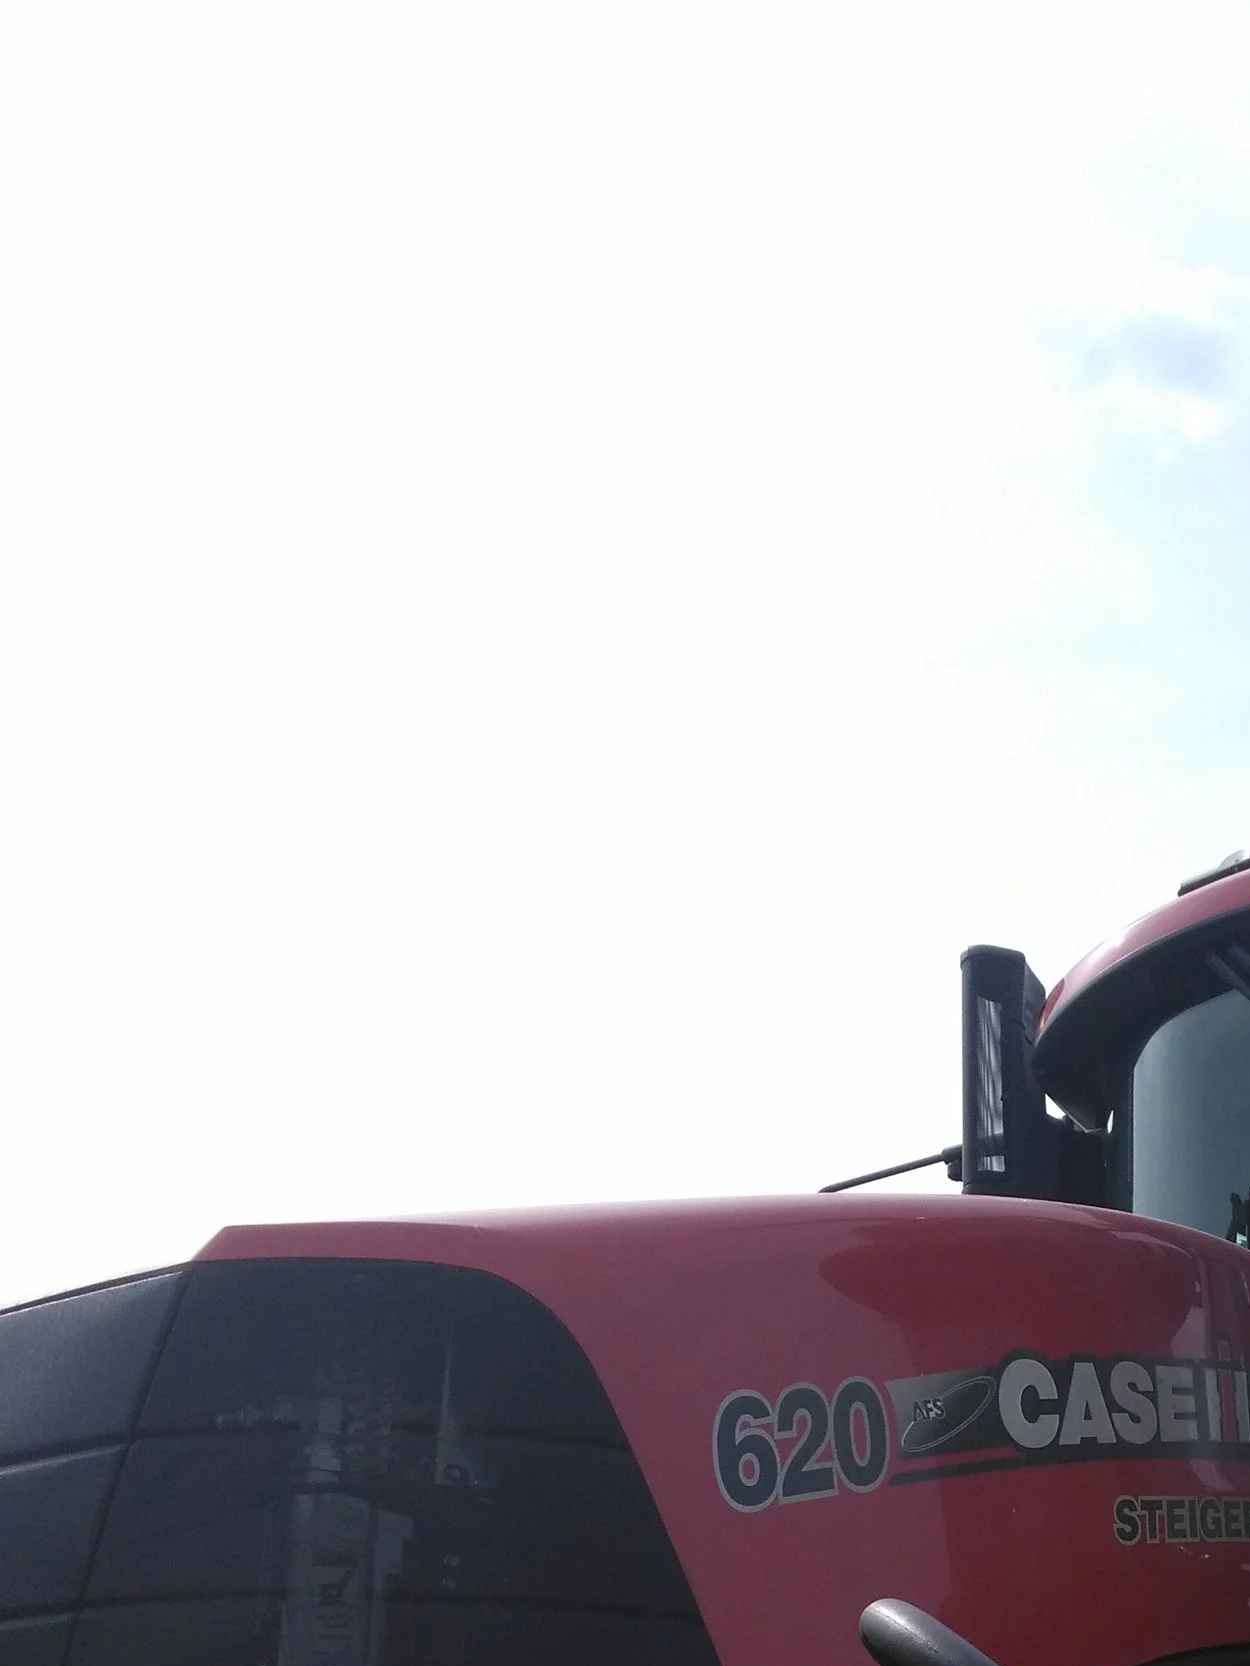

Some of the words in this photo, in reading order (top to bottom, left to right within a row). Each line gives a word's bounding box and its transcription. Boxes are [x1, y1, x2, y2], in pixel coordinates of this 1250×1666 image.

[712, 1375, 889, 1513] 620
[912, 1397, 947, 1422] AFS
[999, 1357, 1200, 1449] CASE
